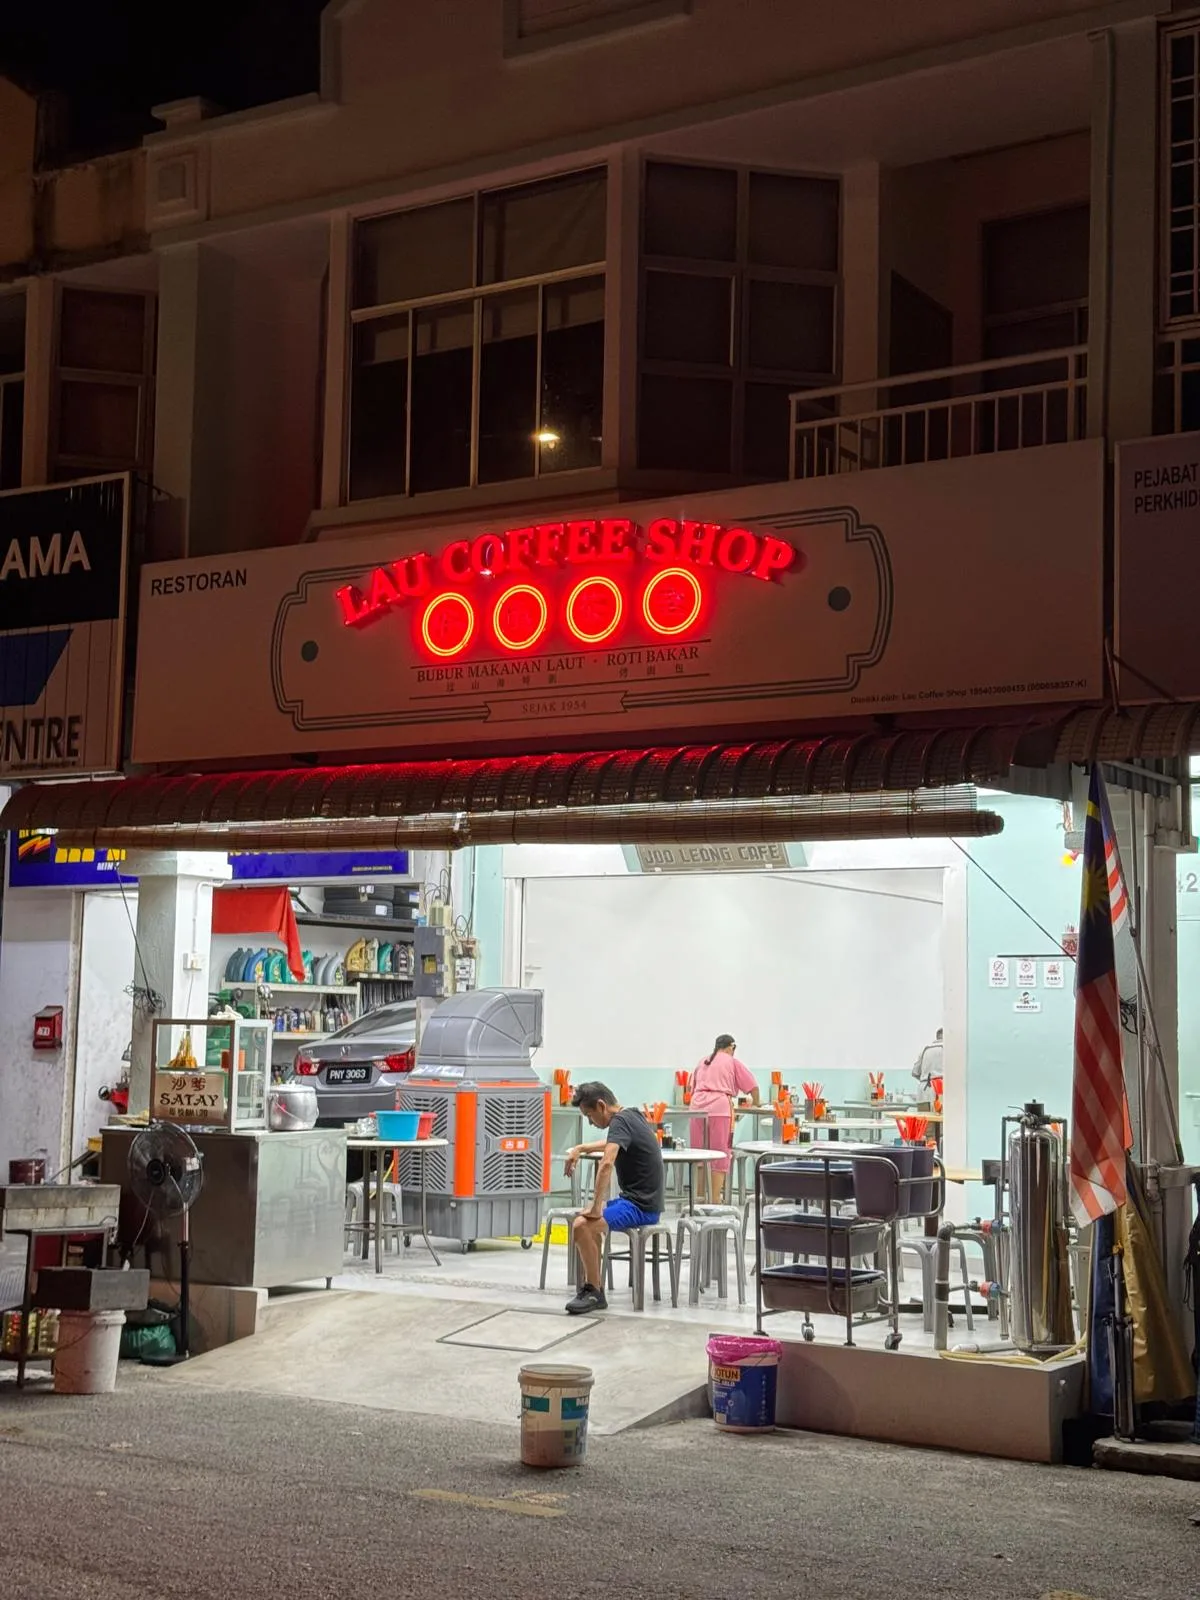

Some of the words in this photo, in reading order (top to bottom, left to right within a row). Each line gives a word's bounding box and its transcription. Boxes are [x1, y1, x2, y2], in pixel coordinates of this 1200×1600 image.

[1134, 463, 1199, 489] PEJABAT
[1134, 489, 1200, 514] PERKHID
[151, 569, 248, 596] RESTORAN
[336, 552, 431, 628] LAU
[441, 518, 637, 583] COFFEE
[646, 517, 797, 581] SHOP
[417, 667, 463, 683] BUBUR
[468, 659, 541, 679] MAKANAN
[547, 656, 585, 672] LAUT
[607, 651, 641, 667] ROTI
[645, 646, 700, 663] BAKAR
[918, 689, 944, 700] Coffee
[522, 701, 556, 715] SEJAK
[561, 699, 587, 711] 1954
[645, 849, 675, 864] JOO
[680, 847, 732, 863] LEONG
[738, 844, 781, 861] CAFE
[329, 1069, 345, 1080] PNY
[345, 1068, 366, 1079] 3063
[160, 1092, 219, 1107] SATAY
